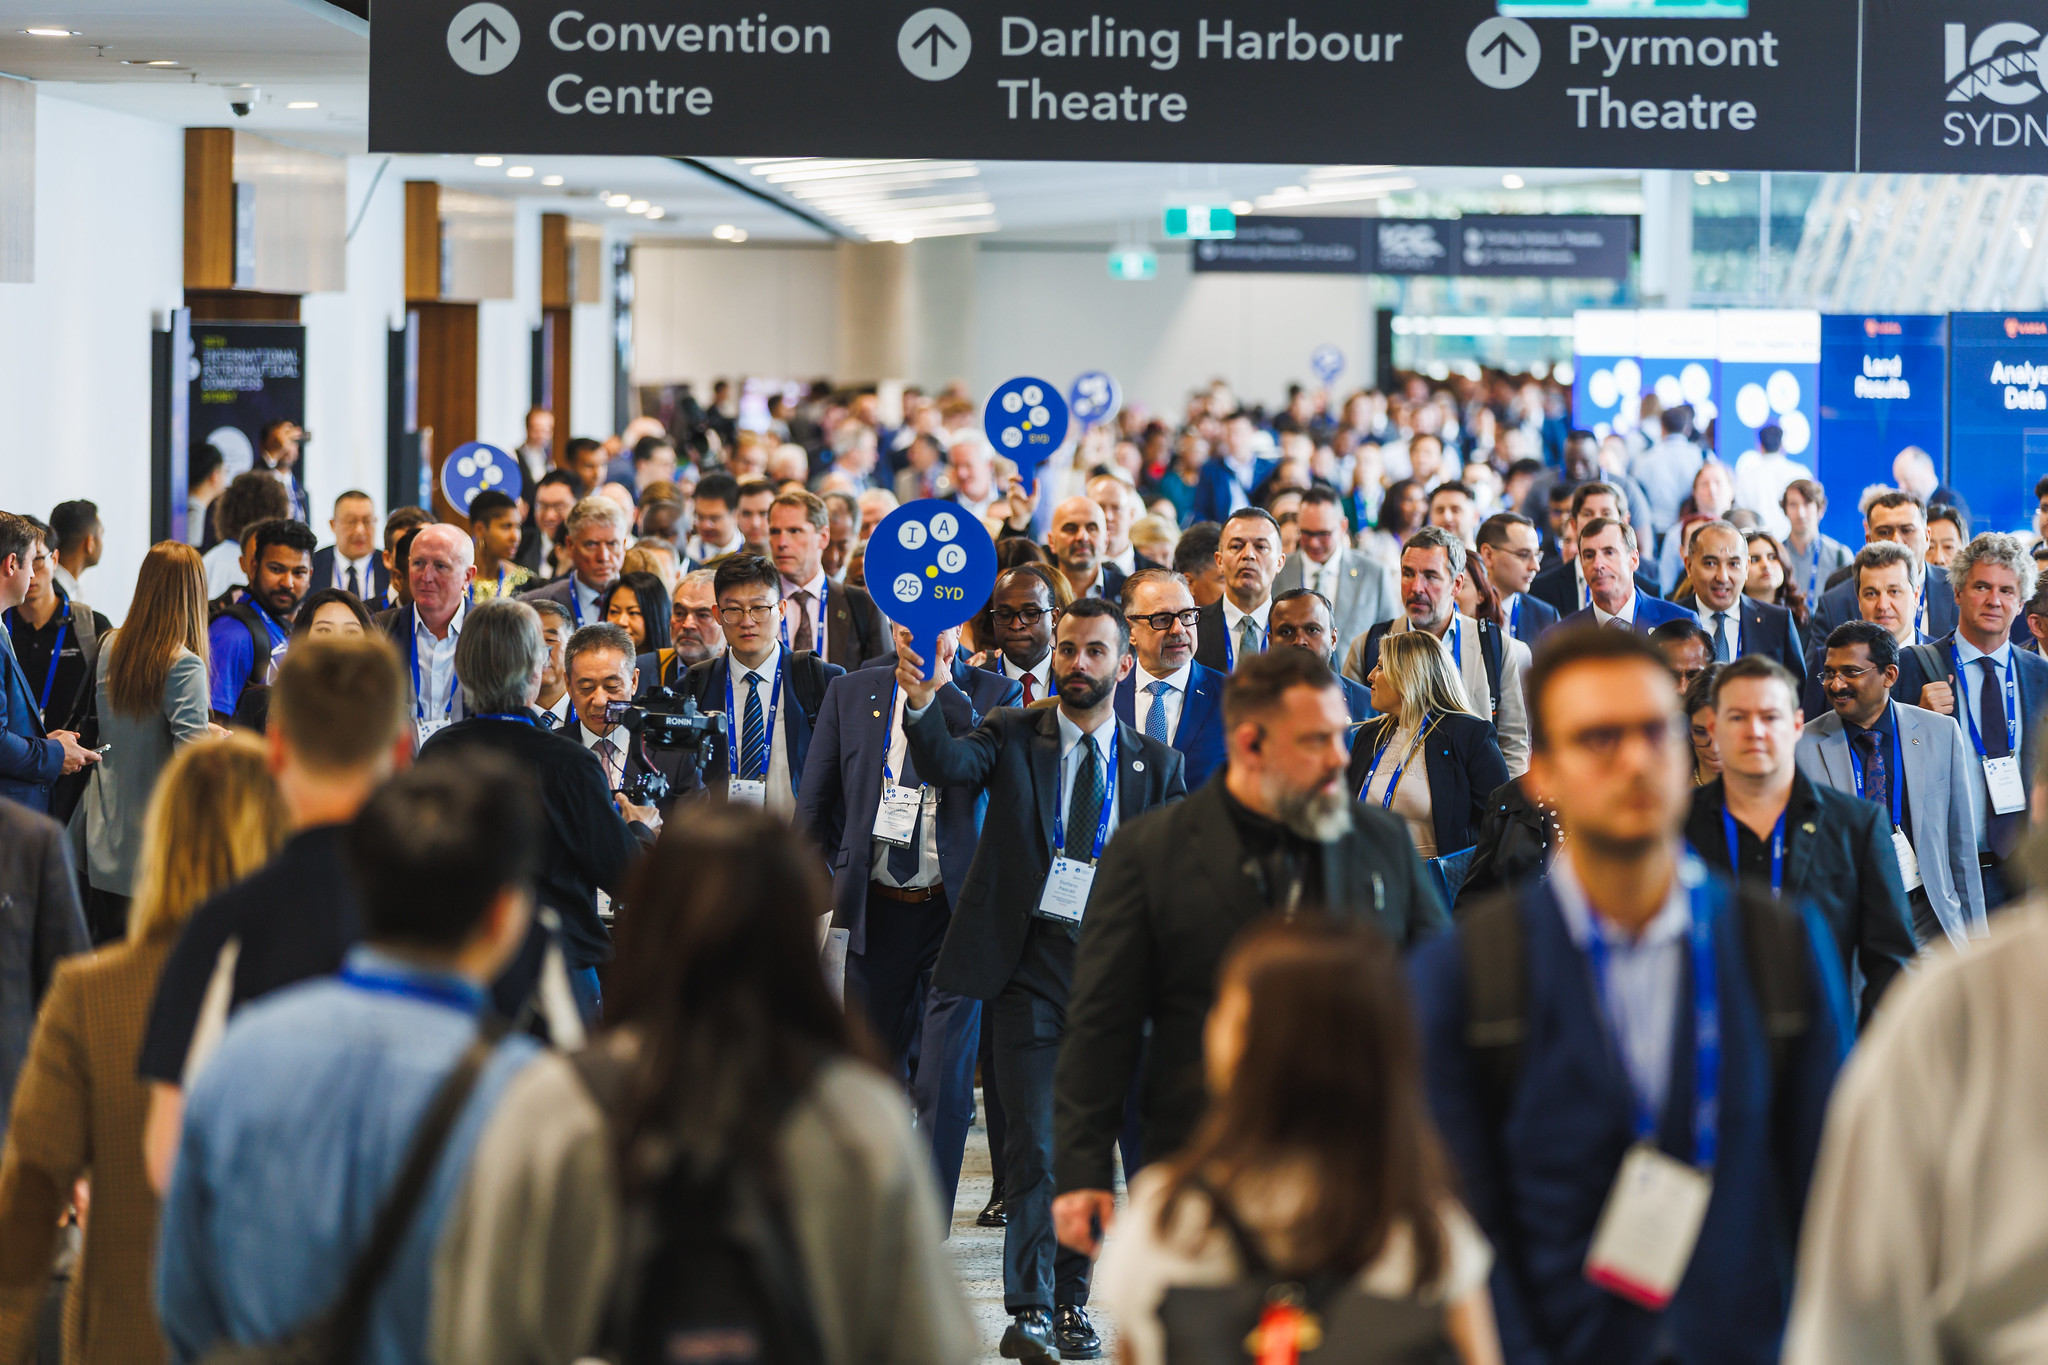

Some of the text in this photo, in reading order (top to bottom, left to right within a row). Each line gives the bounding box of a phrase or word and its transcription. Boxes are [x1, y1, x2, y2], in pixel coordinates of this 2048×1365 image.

[548, 10, 830, 54] Convention
[1001, 15, 1403, 71] Darling Harbour
[1569, 24, 1779, 78] Pyrmont
[547, 73, 713, 116] Centre
[997, 77, 1188, 123] Theatre
[1566, 86, 1758, 131] Theatre
[2004, 385, 2047, 410] Data
[907, 526, 918, 543] I
[938, 519, 950, 536] A
[946, 550, 958, 567] C
[896, 578, 919, 596] 25
[934, 585, 964, 601] SYD
[665, 717, 692, 726] RONIN
